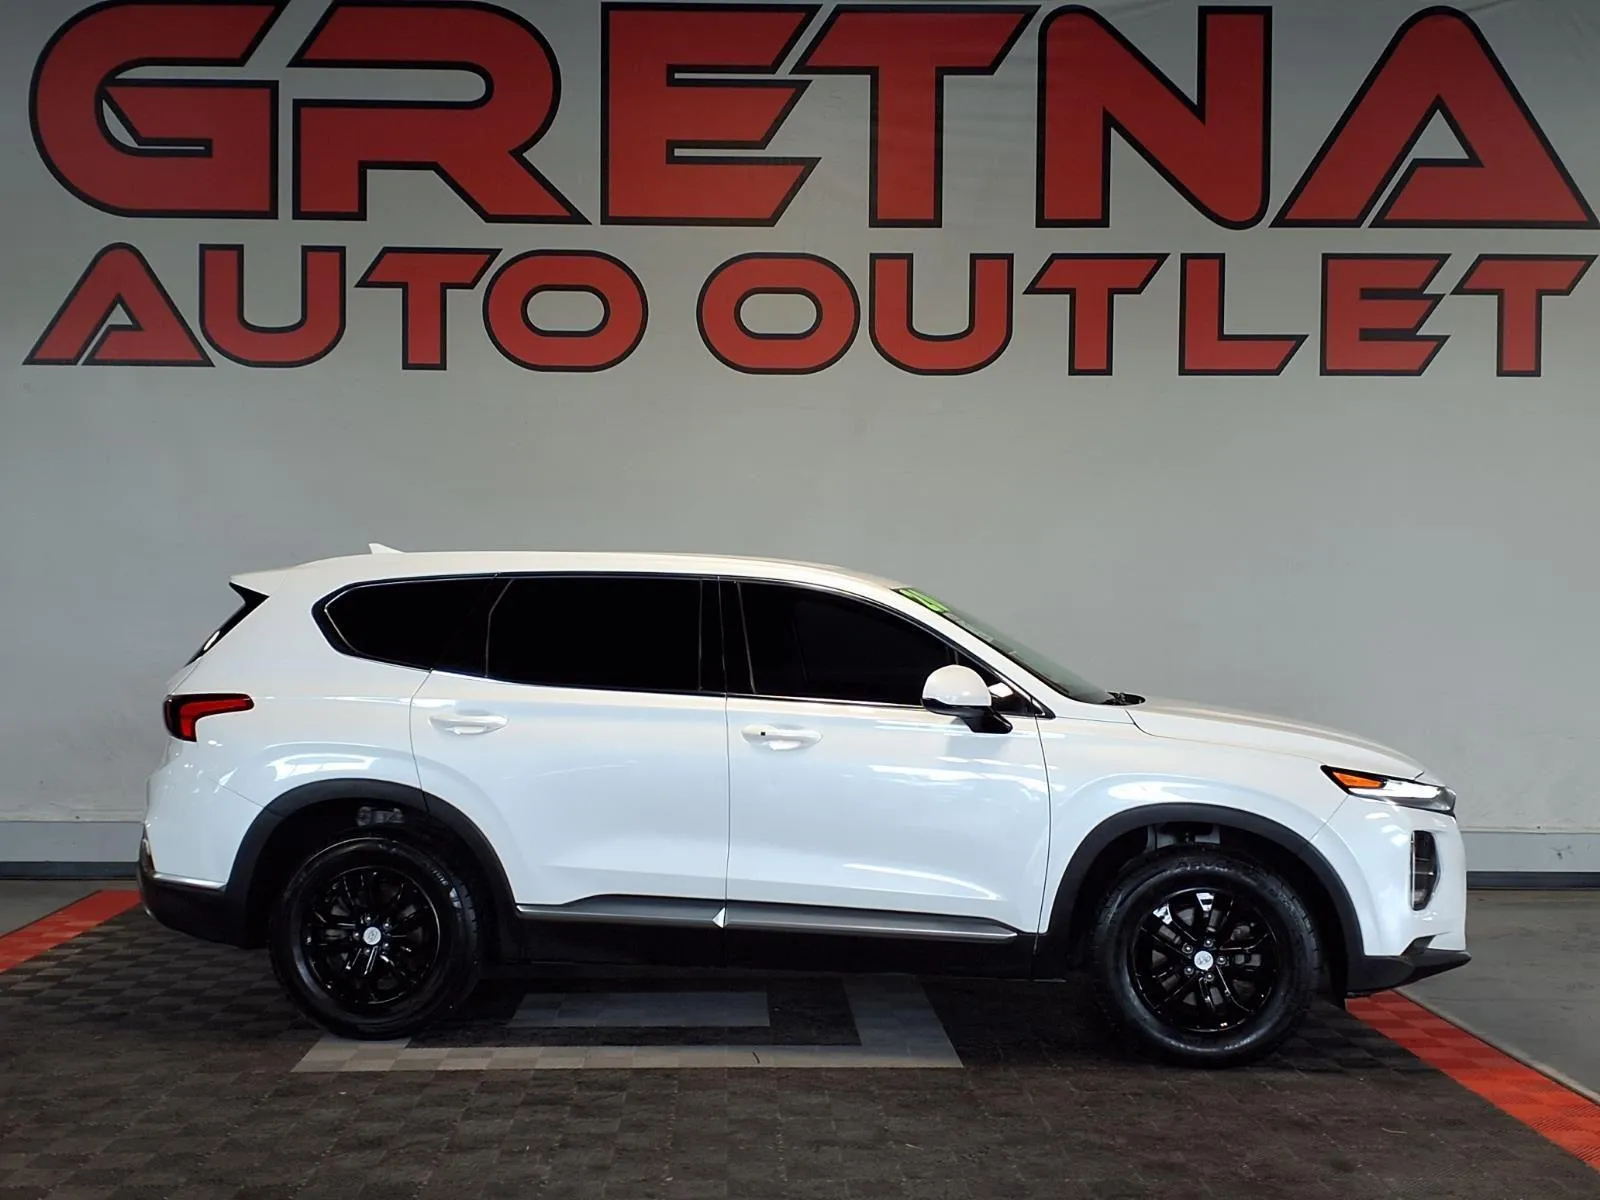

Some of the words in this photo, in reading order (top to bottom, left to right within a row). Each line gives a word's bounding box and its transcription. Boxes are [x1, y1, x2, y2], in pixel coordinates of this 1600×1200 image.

[28, 0, 1600, 230] GRETNA
[22, 241, 649, 373] AUTO
[696, 252, 1598, 378] OUTLET
